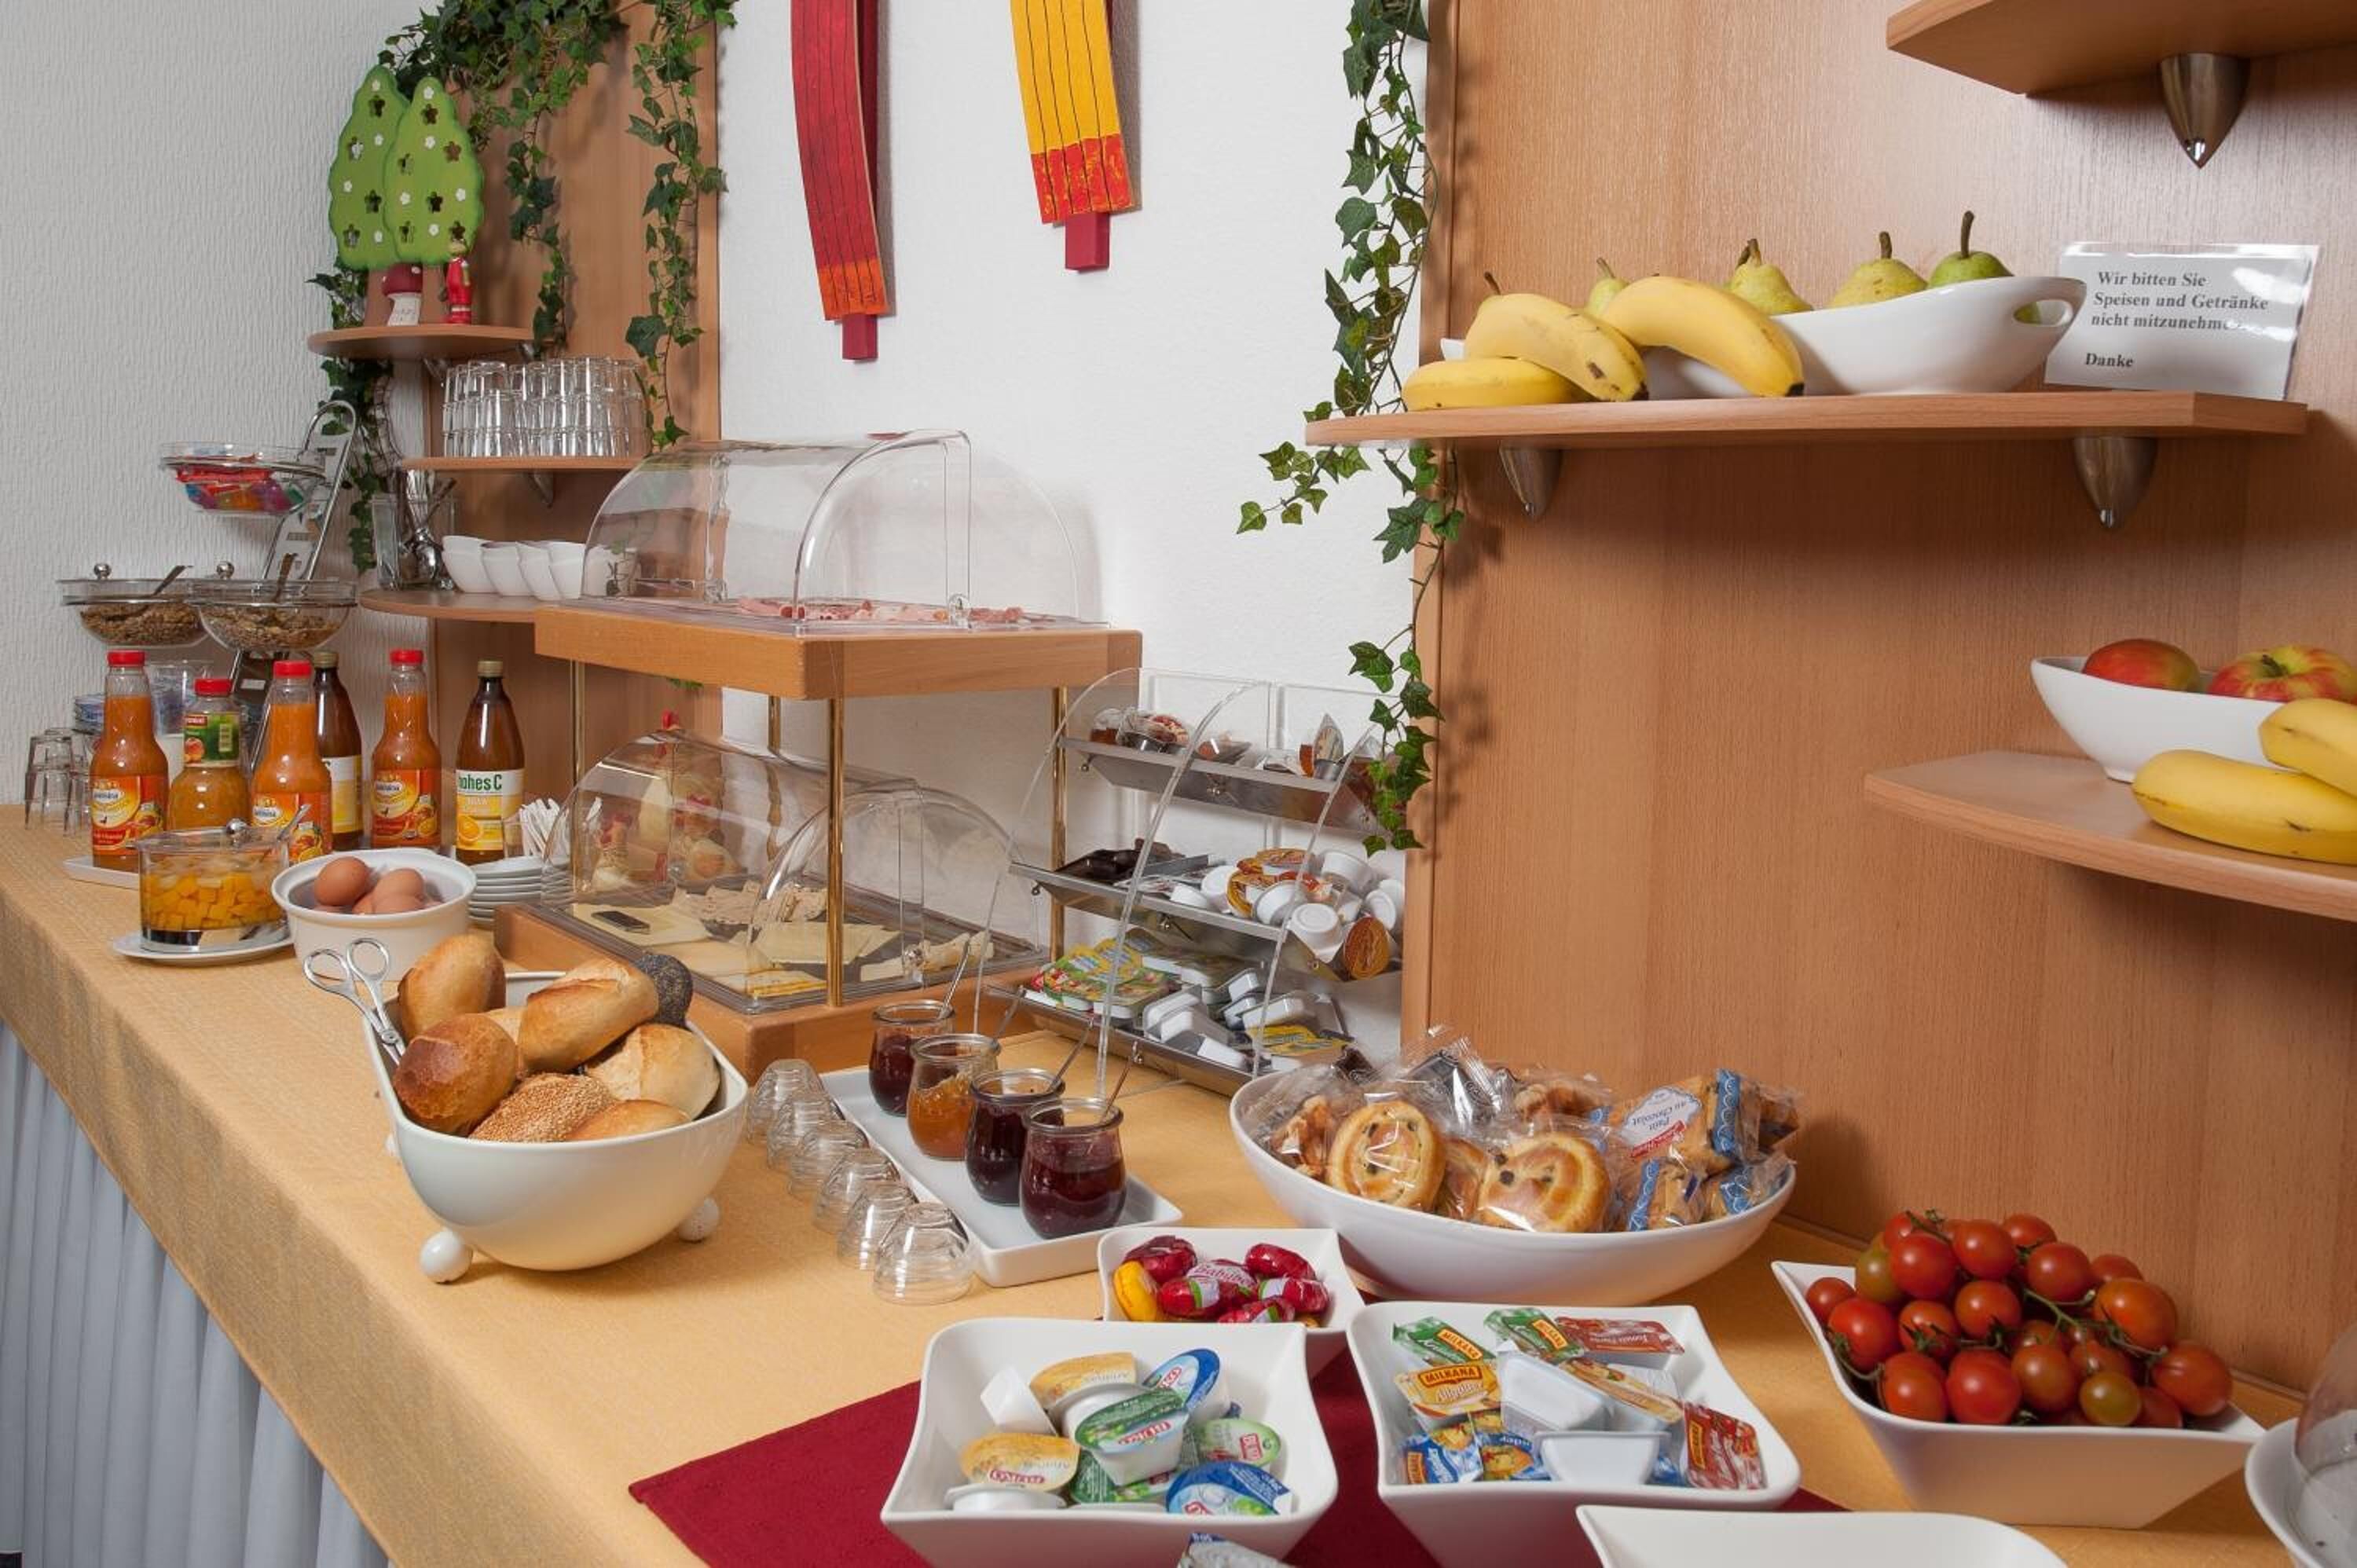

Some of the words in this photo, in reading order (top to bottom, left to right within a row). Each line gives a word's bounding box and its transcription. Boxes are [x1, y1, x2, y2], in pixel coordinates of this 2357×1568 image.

[2098, 271, 2128, 286] Wir
[2132, 271, 2176, 287] bitten
[2181, 272, 2207, 287] Sie
[2092, 291, 2150, 310] Speisen
[2156, 294, 2186, 309] und
[2191, 294, 2269, 311] Getränke
[2091, 312, 2129, 328] nicht
[2133, 314, 2246, 330] mitzunehm
[2085, 352, 2135, 368] Danke
[493, 774, 503, 791] C
[1424, 1367, 1476, 1383] MILKANA
